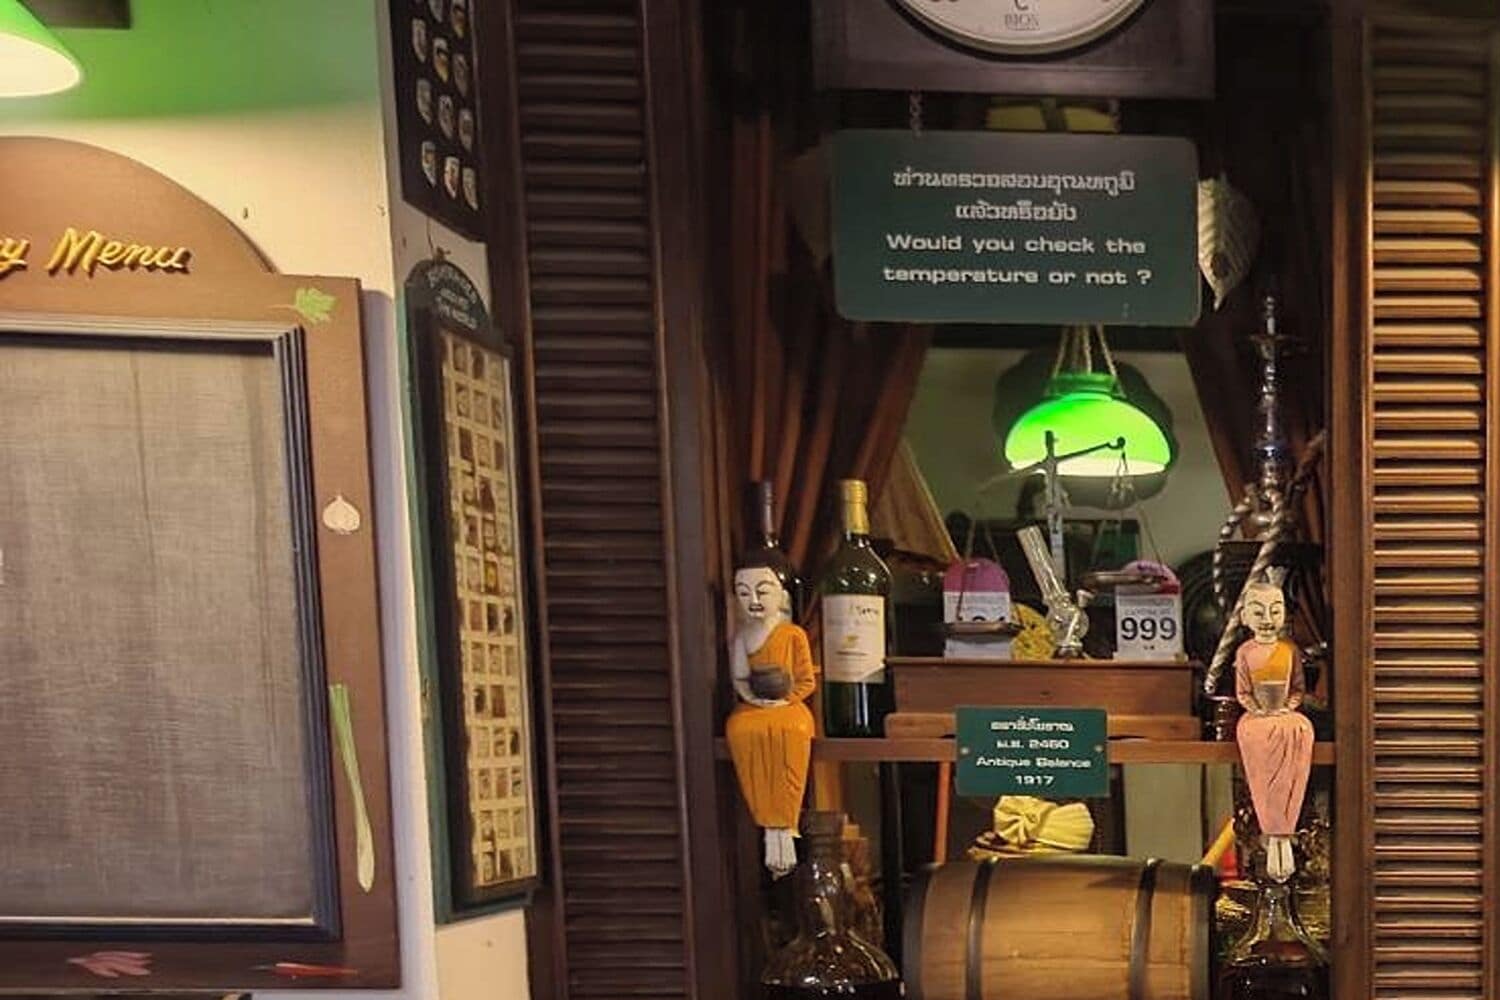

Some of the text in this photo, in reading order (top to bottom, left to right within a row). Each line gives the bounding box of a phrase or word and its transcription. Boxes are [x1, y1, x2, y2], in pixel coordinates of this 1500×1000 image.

[46, 226, 188, 272] Menu
[886, 234, 1146, 254] Would you check the
[883, 267, 1039, 284] temperature
[1048, 272, 1076, 284] or
[1085, 270, 1128, 285] not
[1120, 616, 1178, 641] 999
[976, 756, 1092, 769] Antique Balance
[1014, 774, 1055, 786] 1917
